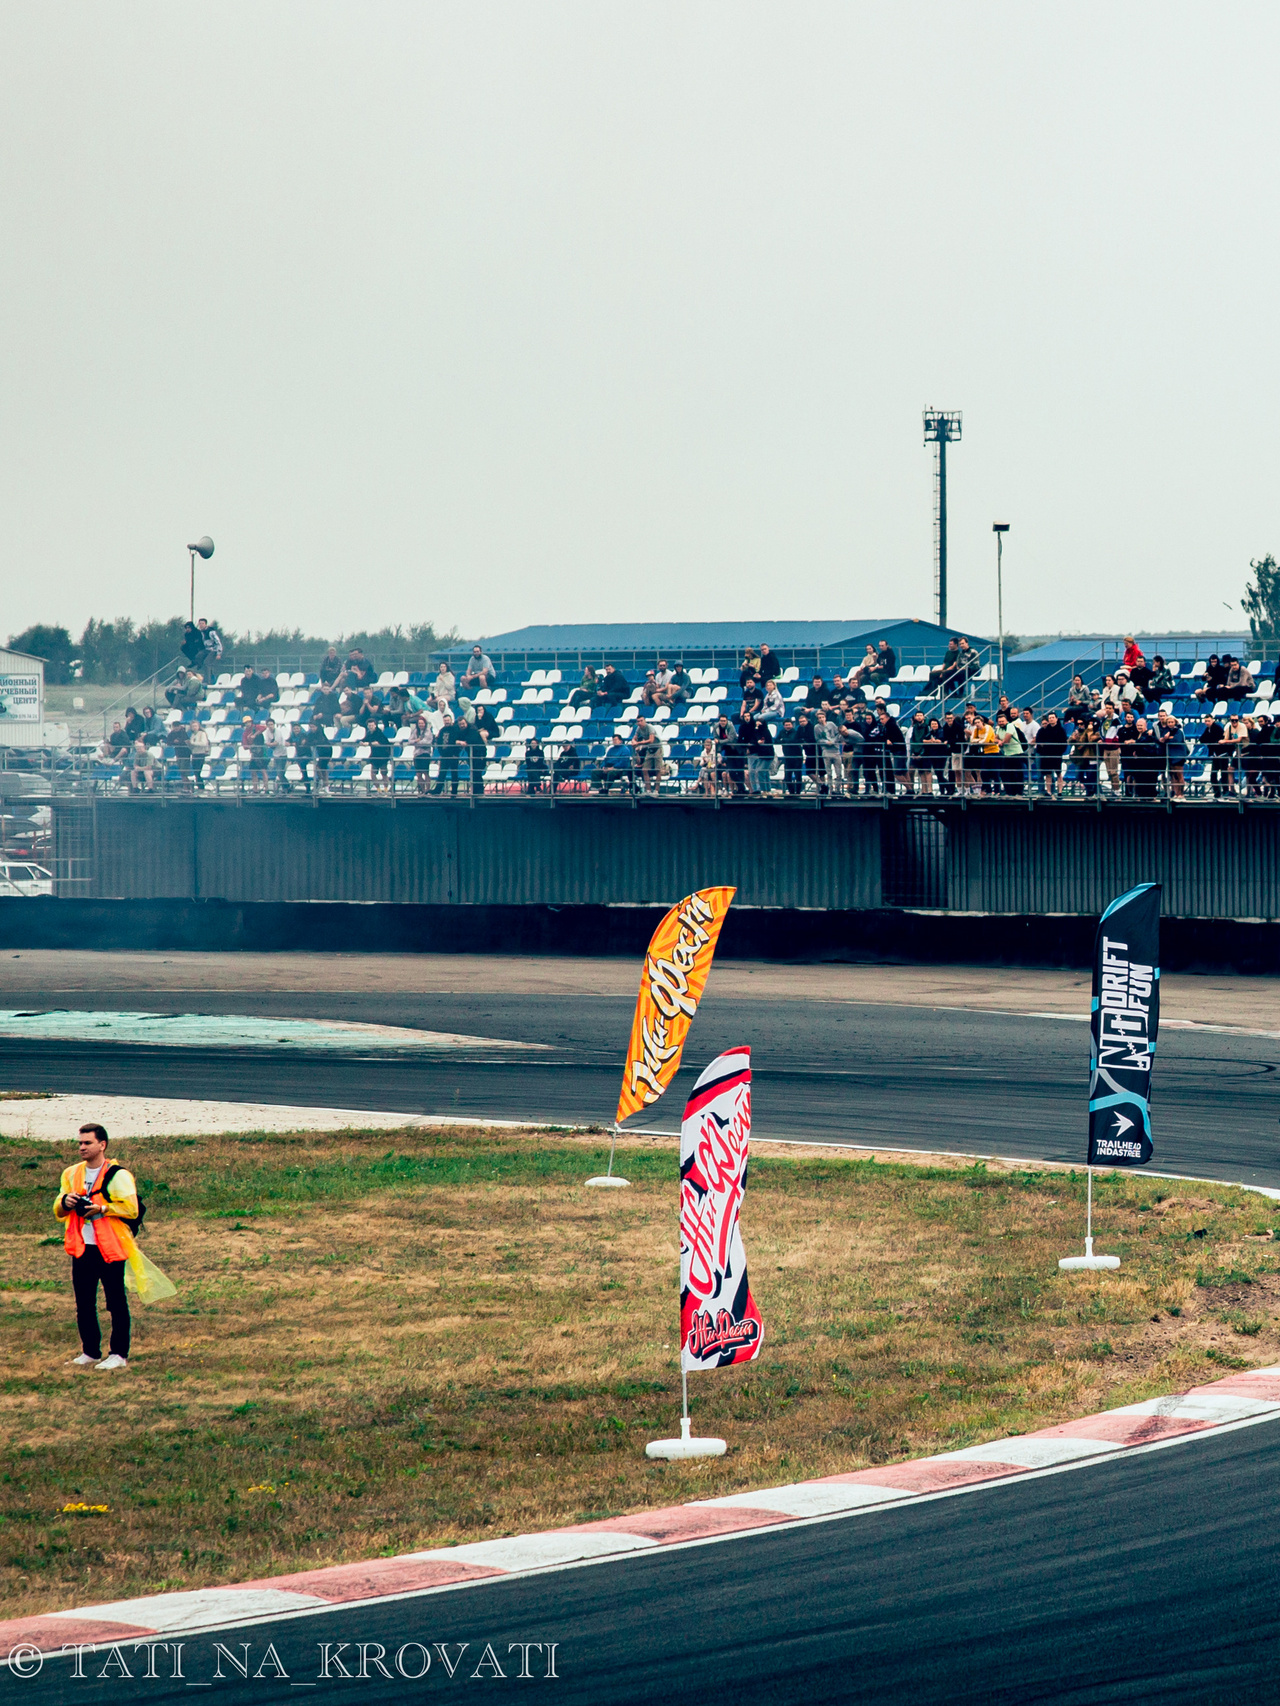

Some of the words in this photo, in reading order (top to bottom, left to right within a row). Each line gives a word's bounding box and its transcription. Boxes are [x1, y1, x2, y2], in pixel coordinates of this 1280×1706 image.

[13, 697, 38, 705] ЦЕНТР
[1101, 936, 1129, 1009] DRIFT
[1128, 962, 1154, 1013] FUN
[1096, 1139, 1142, 1150] TRAILHEAD
